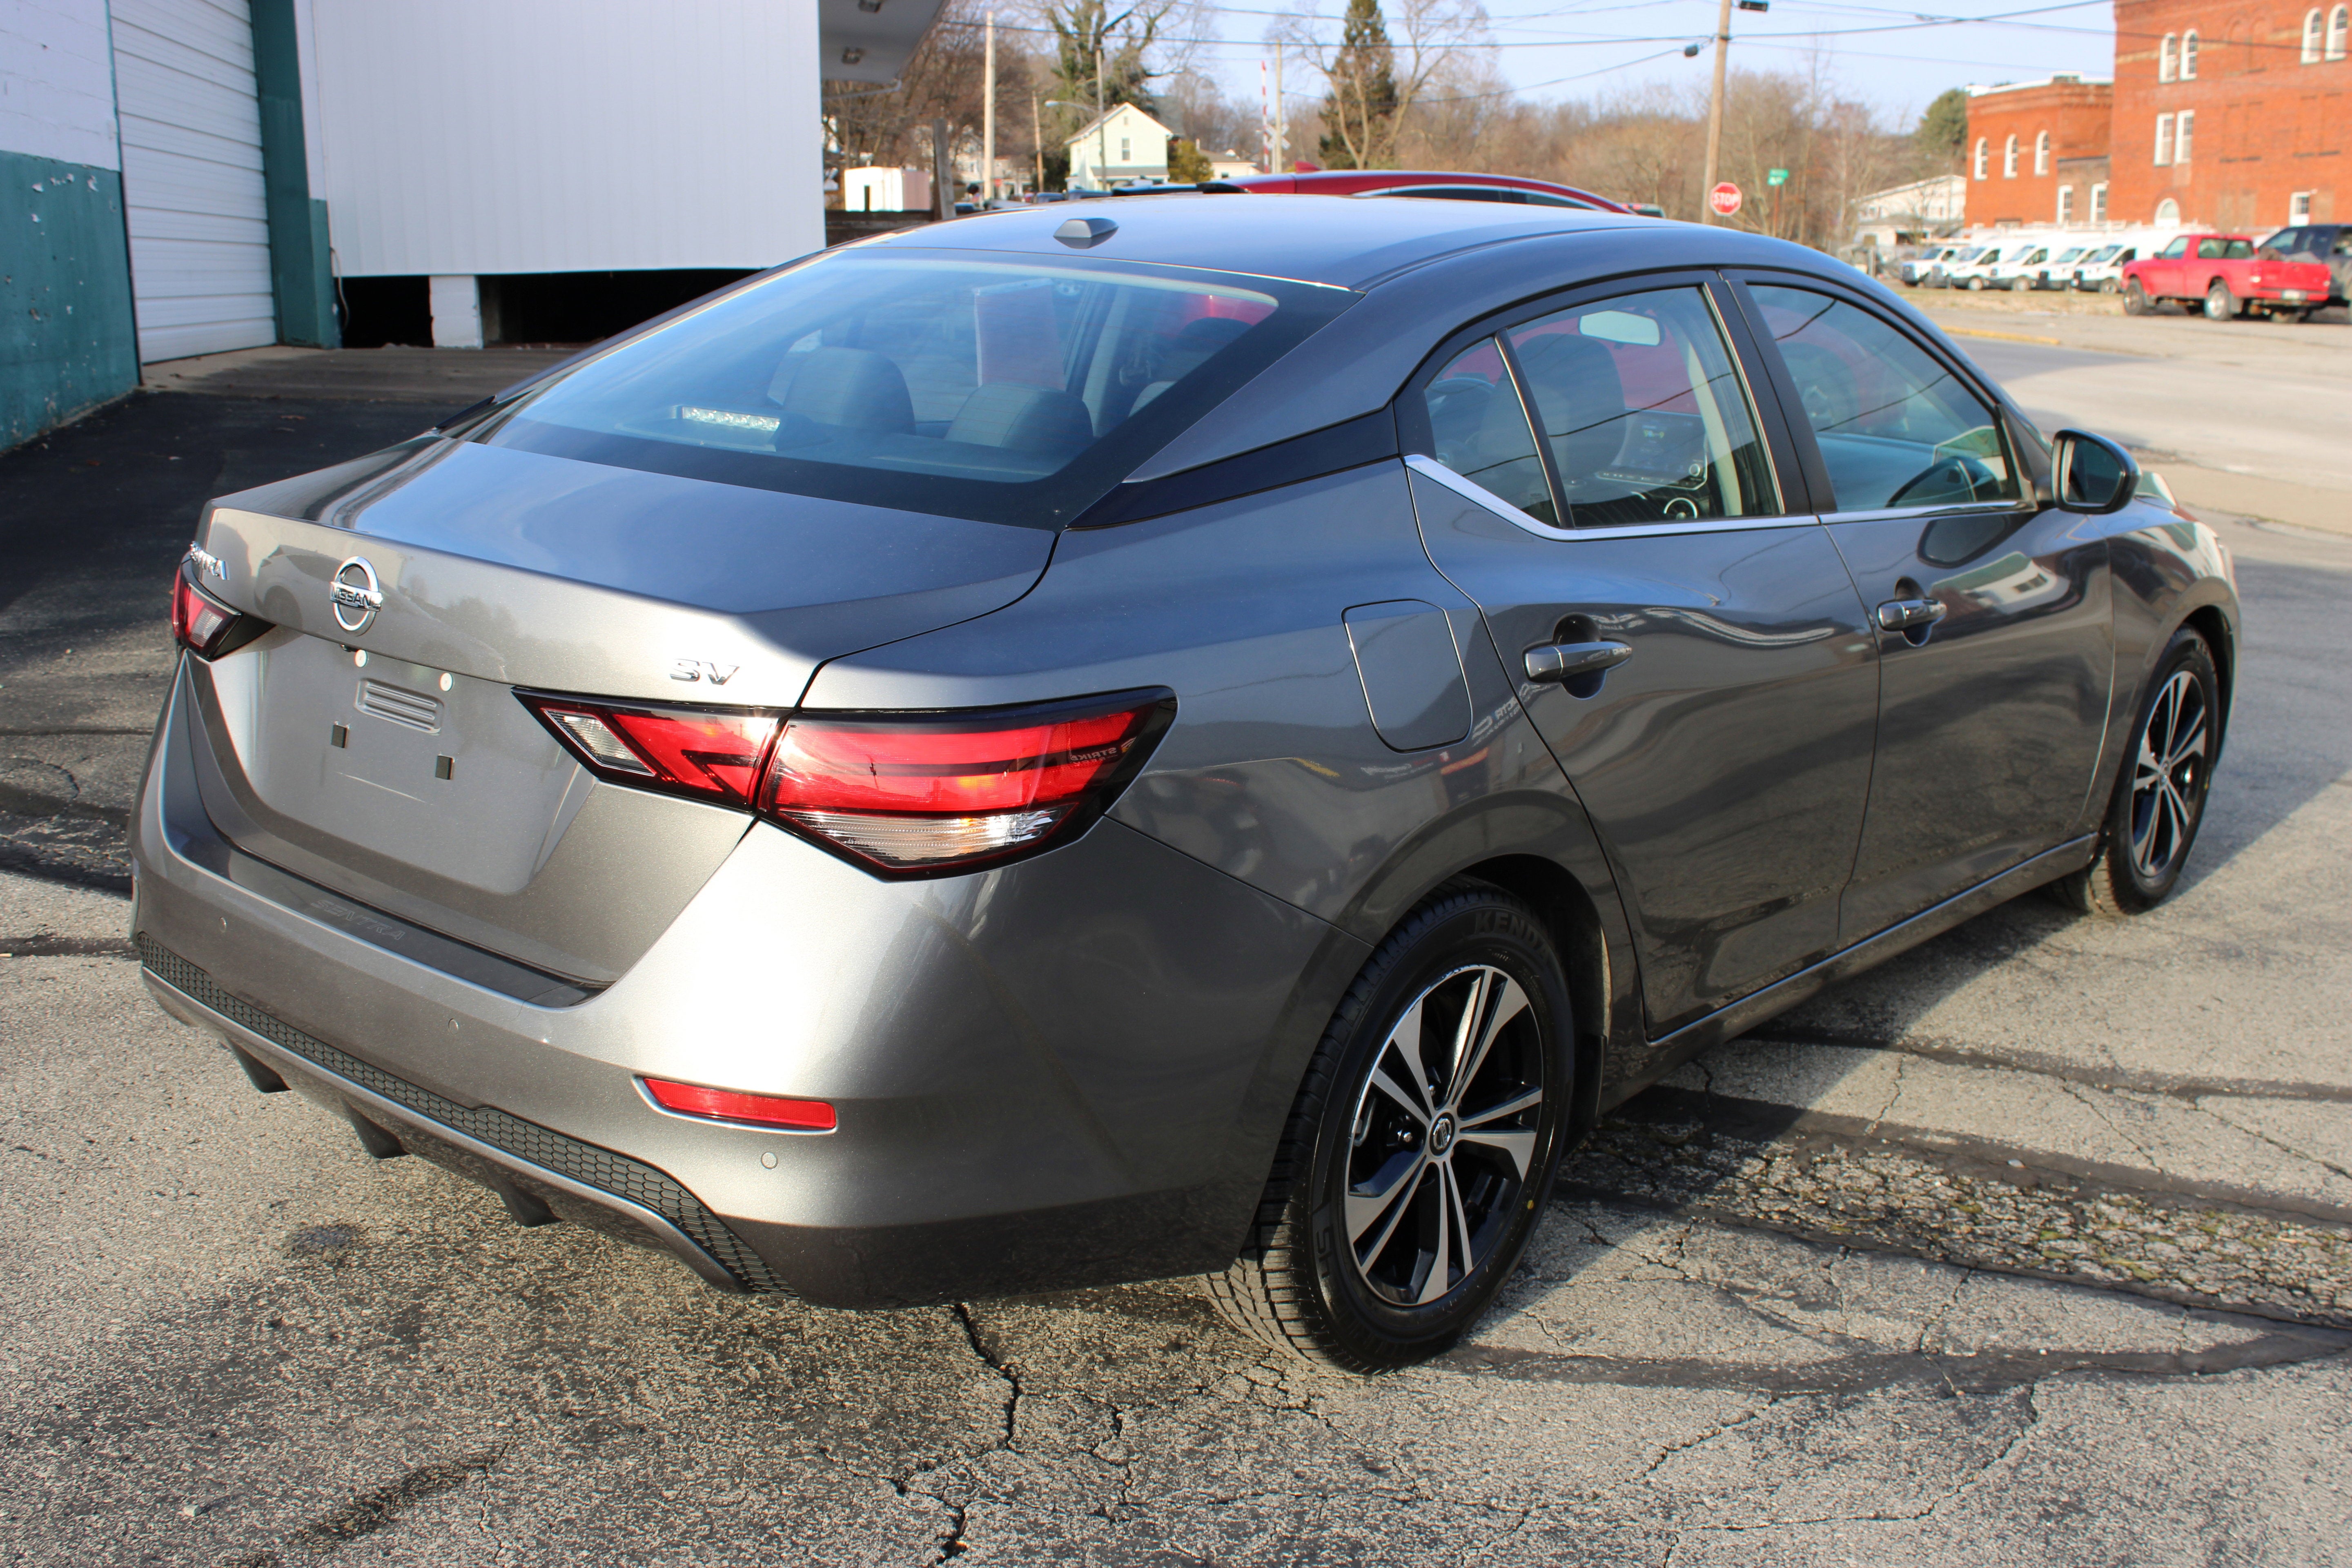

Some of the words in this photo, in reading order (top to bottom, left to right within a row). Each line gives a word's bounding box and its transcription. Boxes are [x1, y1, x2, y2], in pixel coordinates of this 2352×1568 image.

[1713, 192, 1740, 206] STOP
[330, 586, 373, 608] NISSAN
[670, 659, 739, 686] SV
[311, 900, 405, 940] SENTRA
[1474, 911, 1549, 964] KENDA
